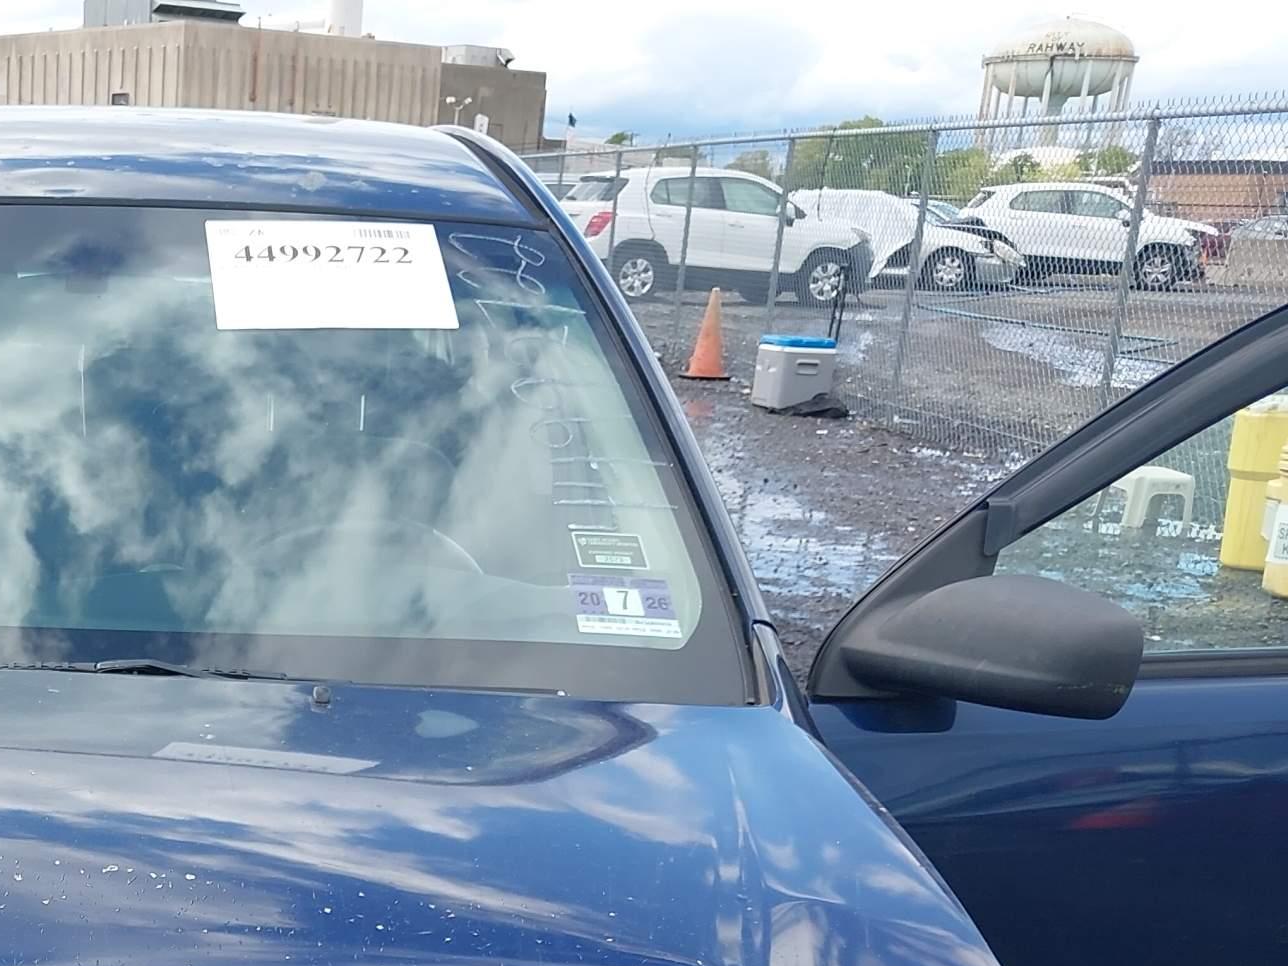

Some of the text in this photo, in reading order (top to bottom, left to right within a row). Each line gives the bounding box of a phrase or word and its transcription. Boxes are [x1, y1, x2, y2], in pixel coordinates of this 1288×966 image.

[1026, 41, 1086, 53] RAHWAY
[233, 244, 413, 264] 44992722
[578, 589, 669, 610] 20 7 26
